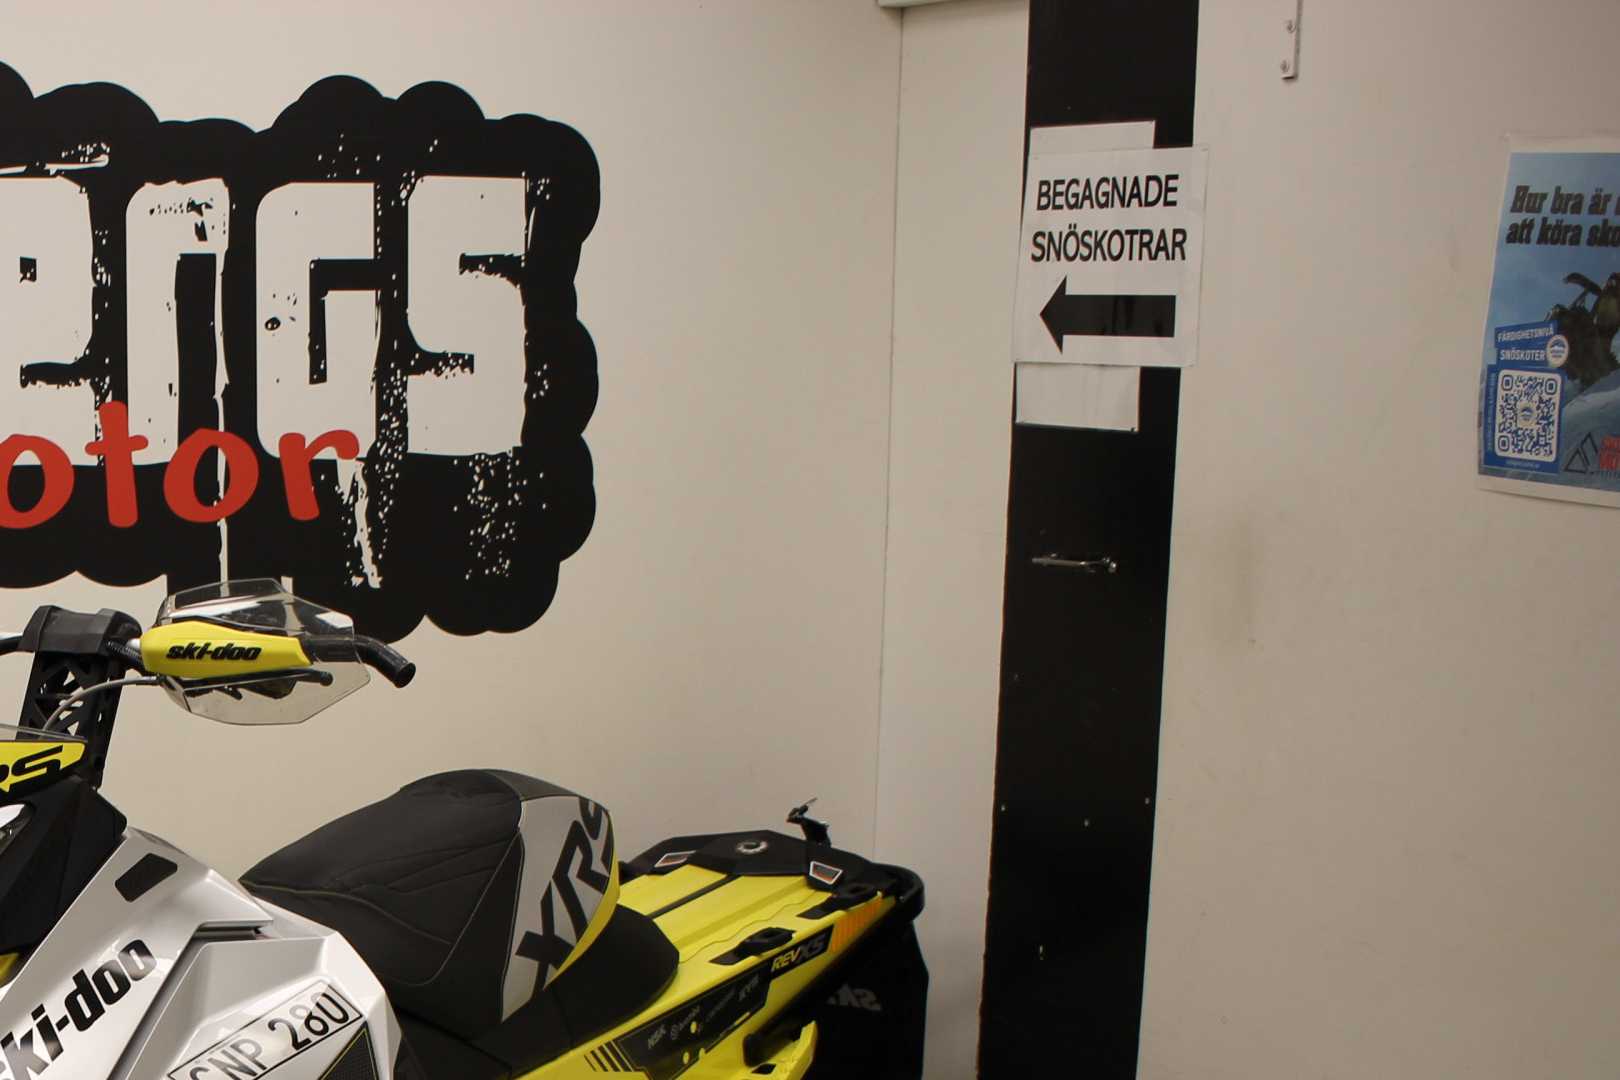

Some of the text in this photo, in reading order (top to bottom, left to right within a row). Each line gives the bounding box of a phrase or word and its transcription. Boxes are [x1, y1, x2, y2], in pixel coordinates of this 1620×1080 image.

[1036, 174, 1180, 211] BEGAGNADE
[1510, 185, 1548, 214] Hur
[1550, 186, 1584, 215] bra
[1588, 187, 1612, 216] är
[1030, 224, 1188, 263] SNÖSKOTRAR
[1506, 218, 1535, 244] att
[1536, 217, 1582, 246] köra
[1497, 327, 1555, 343] FÄRDIGHETSNIVÅ
[1499, 346, 1546, 361] SNÖSKOTER
[166, 642, 262, 661] ski-doo
[267, 991, 350, 1051] 280
